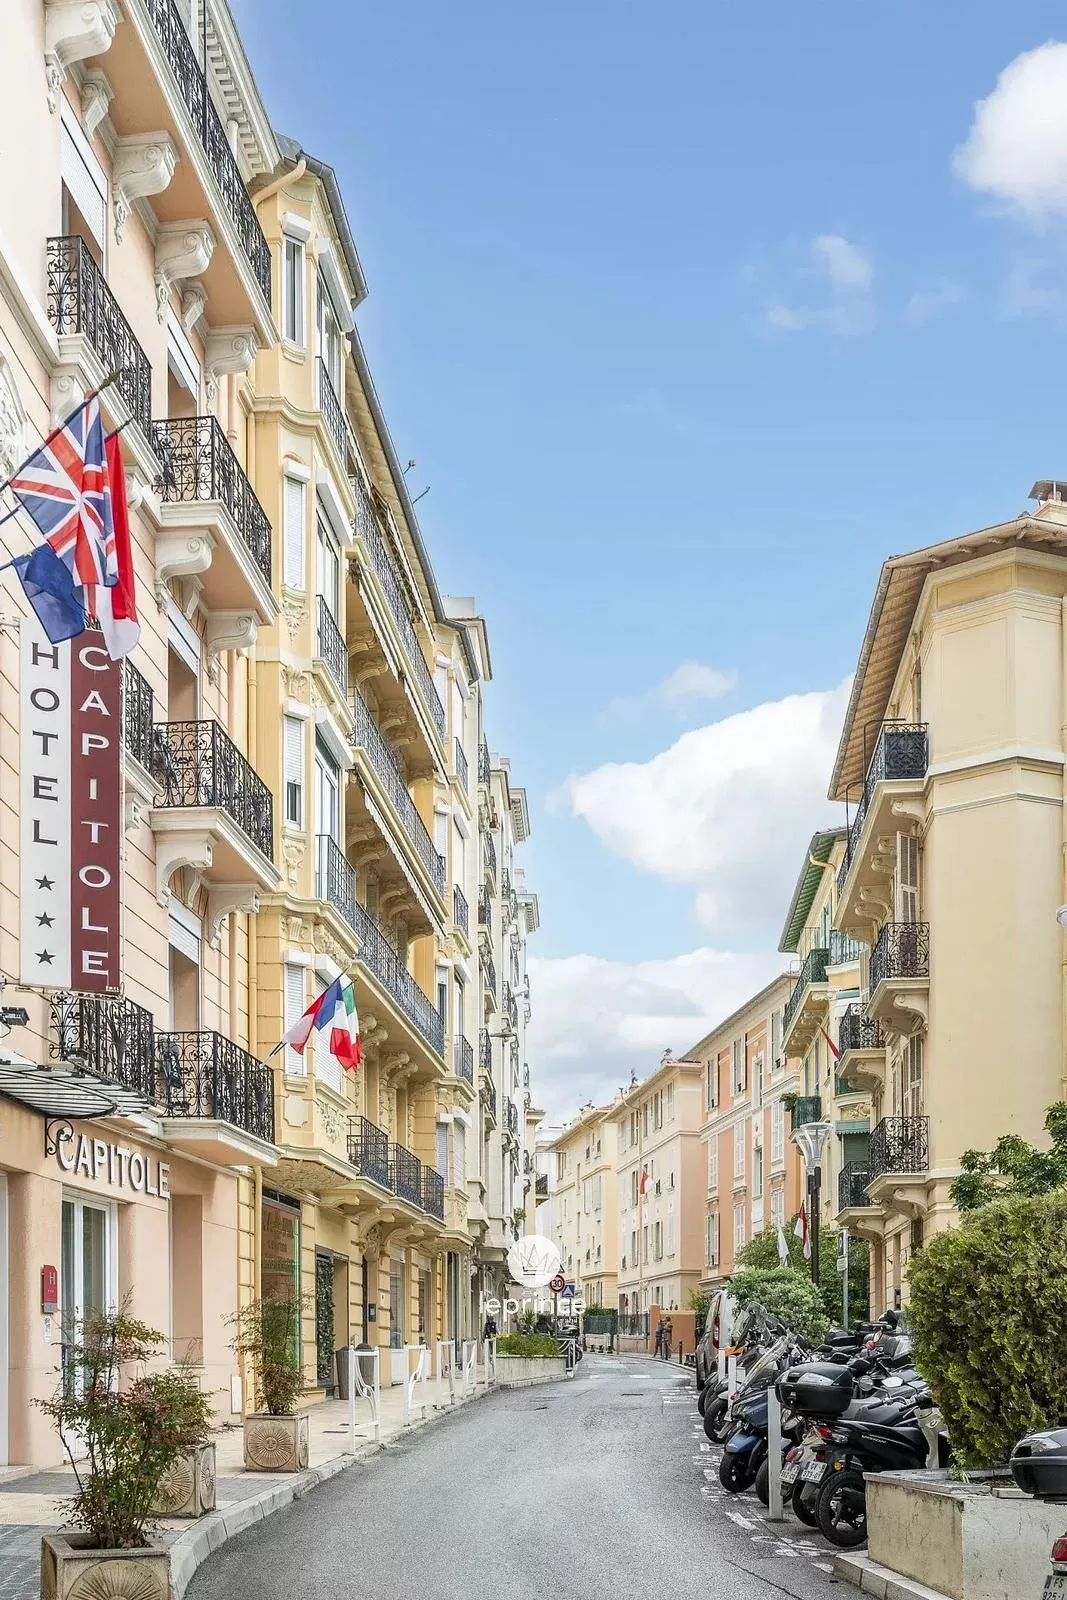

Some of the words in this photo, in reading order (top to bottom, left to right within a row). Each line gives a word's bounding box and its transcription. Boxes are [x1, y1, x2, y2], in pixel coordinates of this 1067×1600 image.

[30, 642, 60, 846] HOTEL
[78, 645, 111, 977] CAPITOLE
[57, 1127, 171, 1200] CAPITOLE
[552, 1279, 563, 1288] 30
